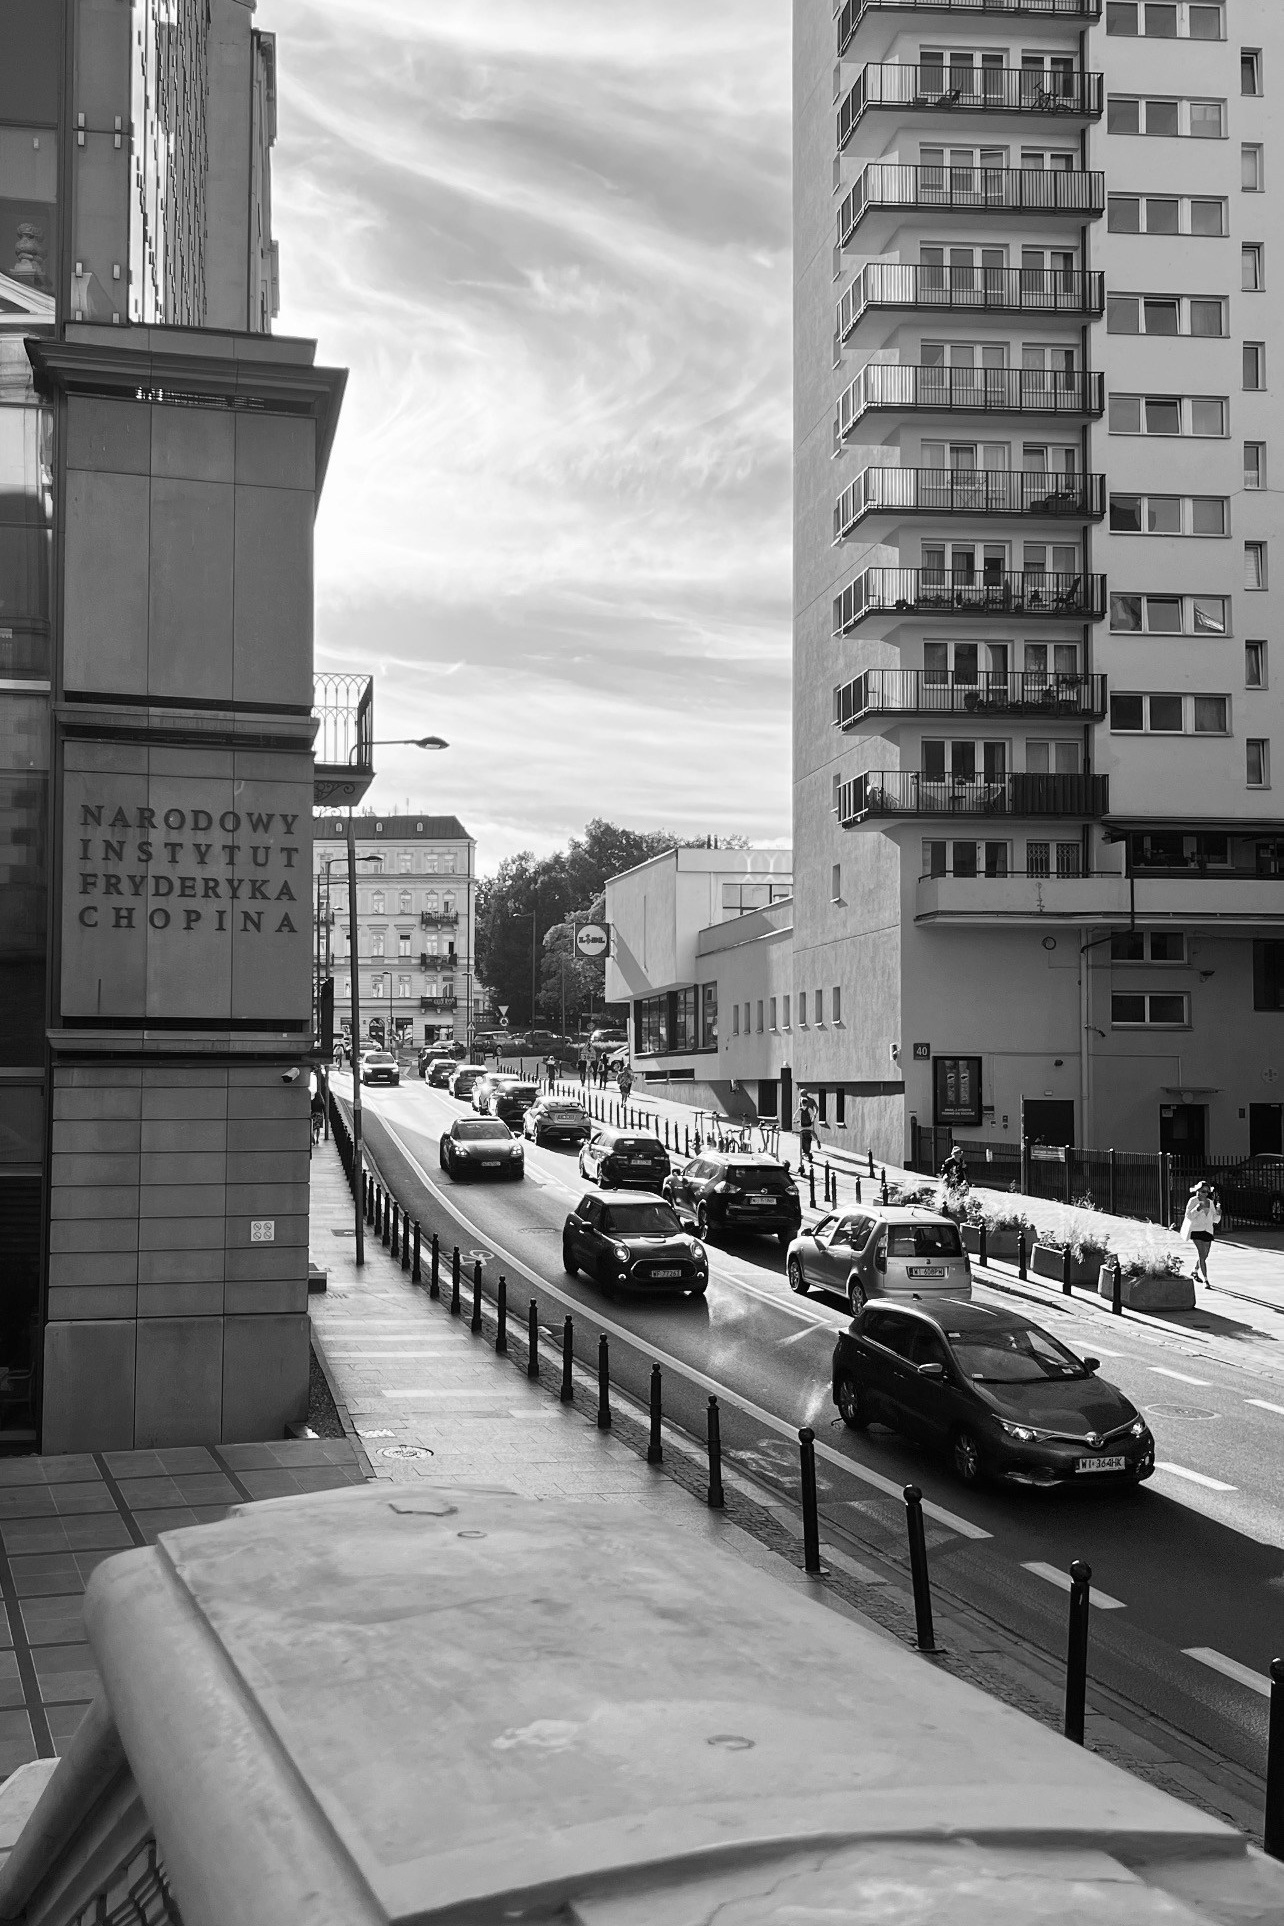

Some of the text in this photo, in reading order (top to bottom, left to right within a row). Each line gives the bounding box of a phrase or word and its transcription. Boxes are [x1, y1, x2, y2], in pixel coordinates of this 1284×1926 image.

[80, 804, 299, 835] NARODOWY
[79, 838, 299, 868] INSTYTUT
[79, 872, 298, 901] FRYDERYKA
[78, 905, 298, 933] CHOPINA
[916, 1046, 928, 1056] 40
[1081, 1457, 1122, 1469] WI 364HK
